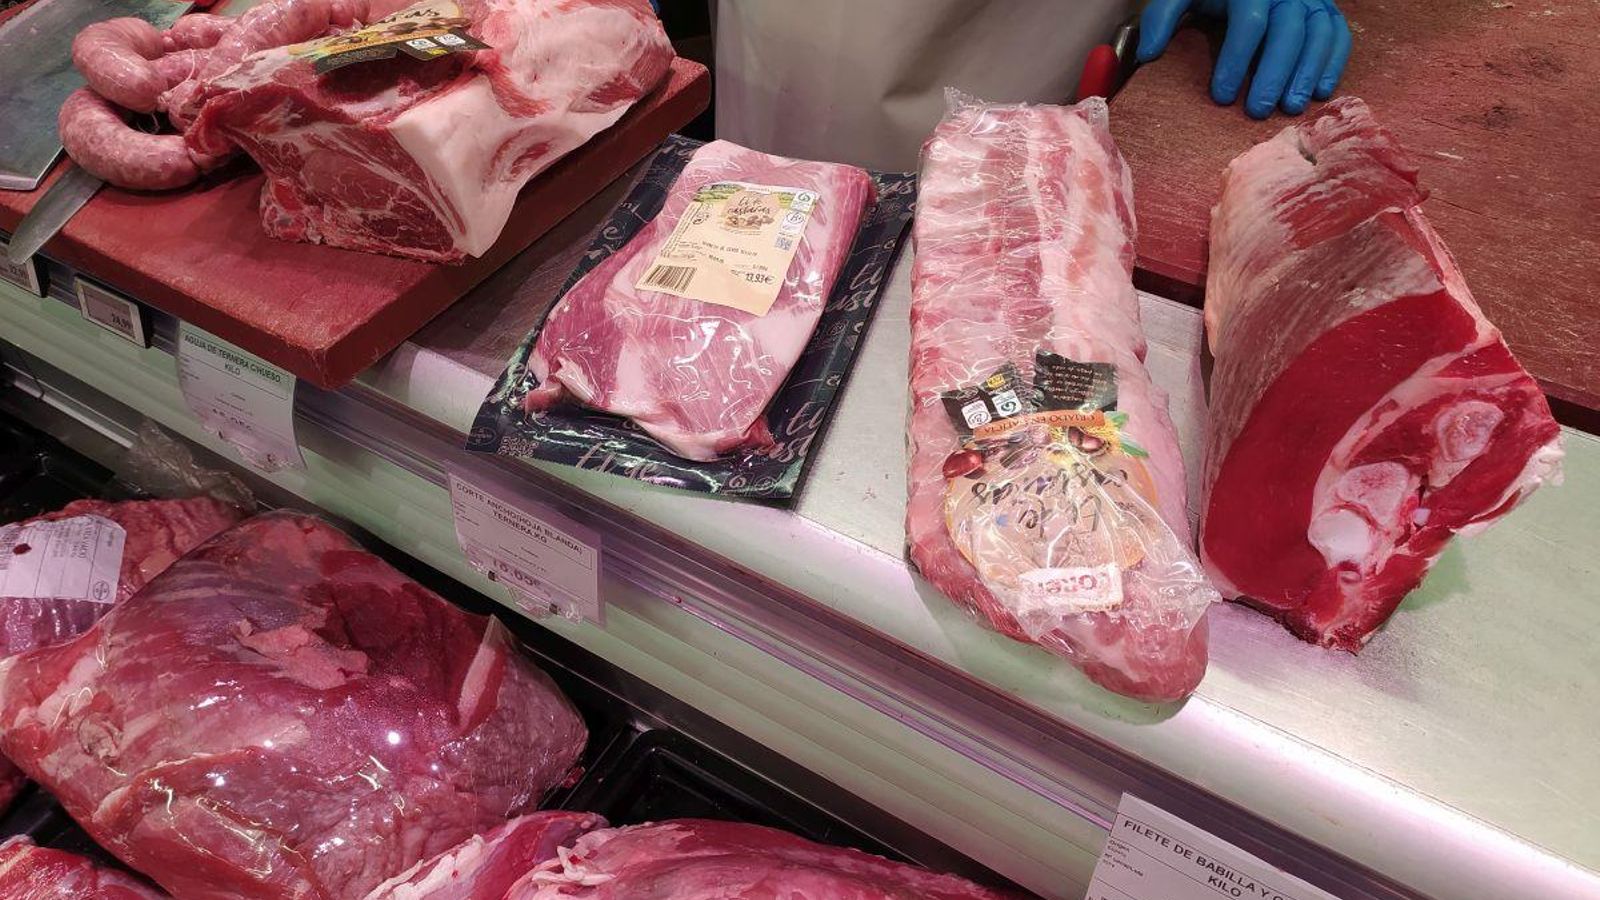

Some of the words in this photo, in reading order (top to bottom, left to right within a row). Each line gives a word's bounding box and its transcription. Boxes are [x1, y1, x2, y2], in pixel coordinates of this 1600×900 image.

[207, 344, 217, 355] DE
[218, 349, 250, 370] TERNERA
[224, 362, 241, 376] KILO
[456, 483, 484, 502] CORTE
[1123, 819, 1171, 849] FILETE
[1173, 842, 1193, 860] DE
[1196, 855, 1257, 893] BABILLA
[1259, 886, 1270, 898] Y
[1207, 875, 1242, 898] KILO
